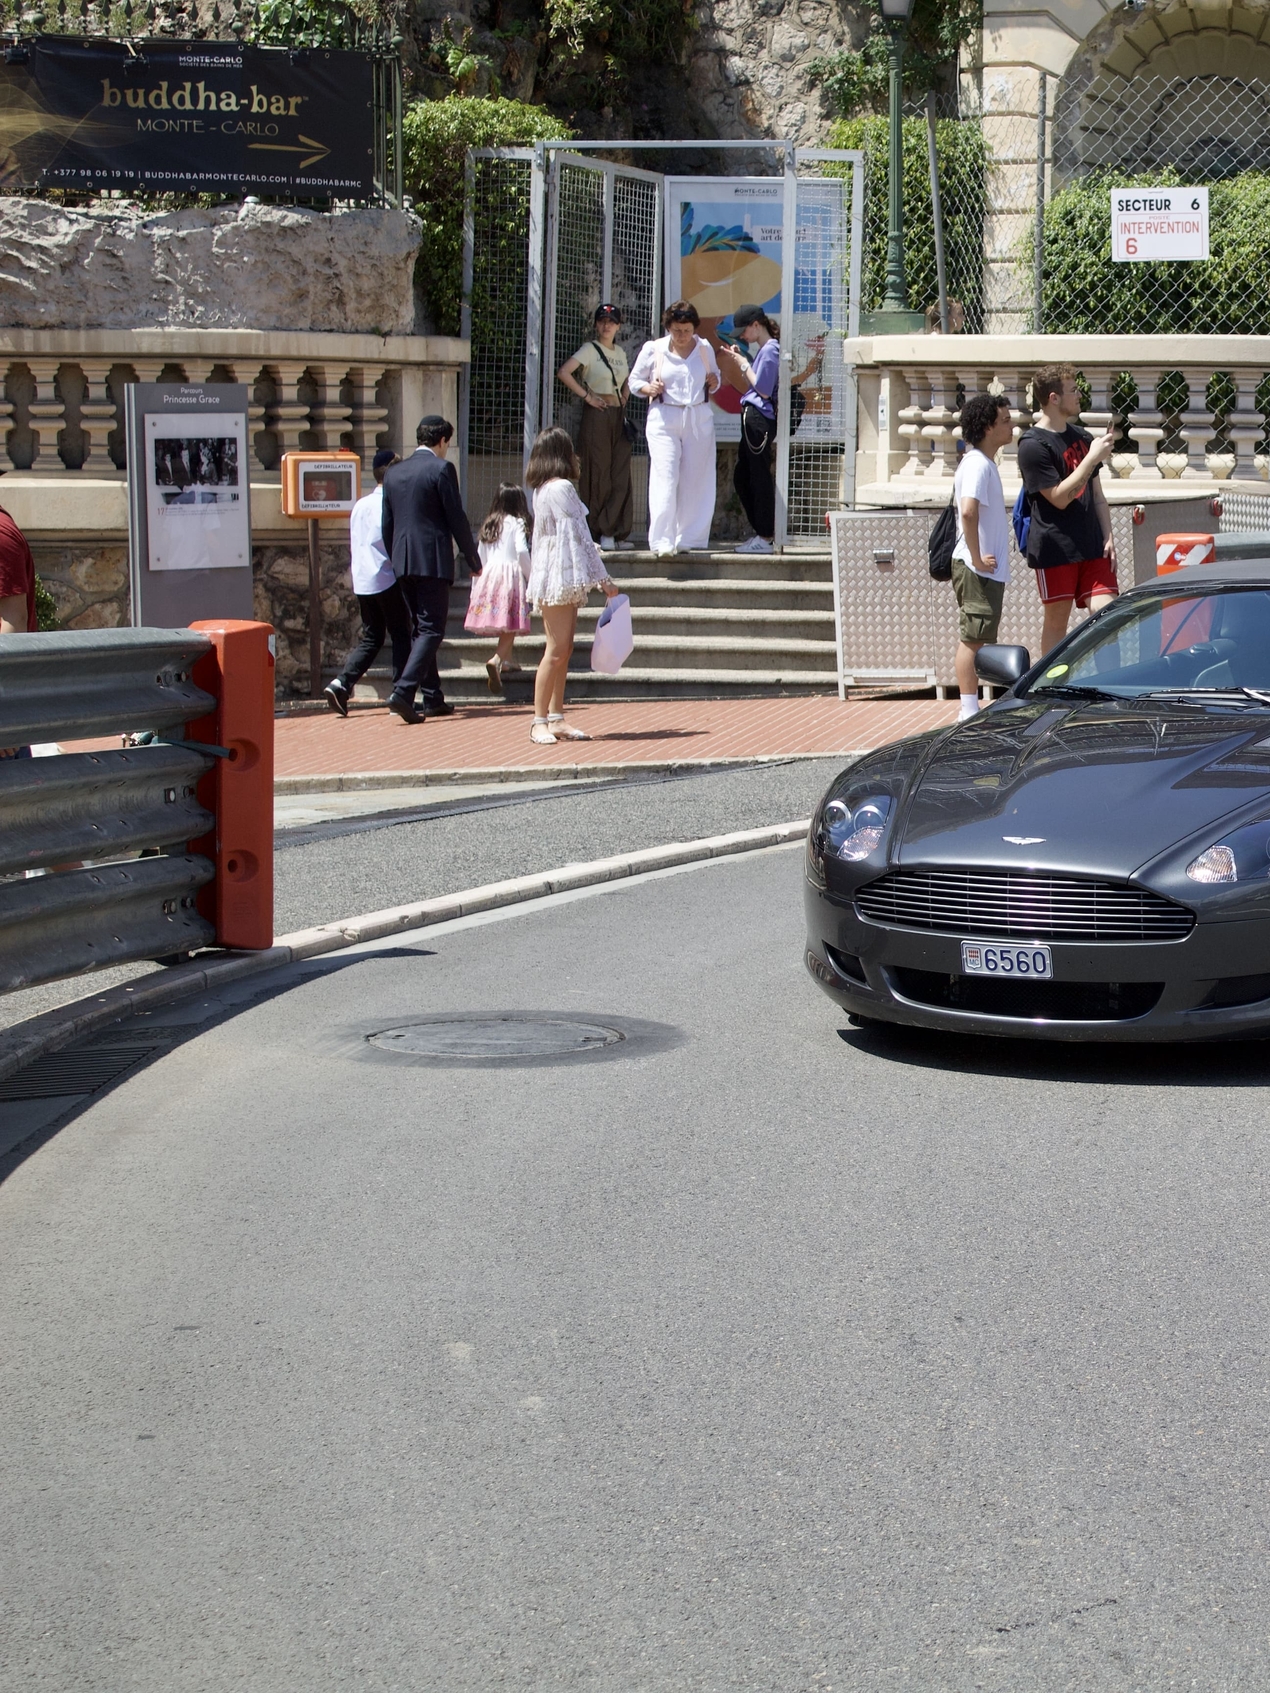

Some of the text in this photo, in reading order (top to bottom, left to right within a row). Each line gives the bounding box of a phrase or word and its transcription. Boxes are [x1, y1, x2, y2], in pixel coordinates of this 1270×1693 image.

[101, 78, 302, 116] buddha-bar
[137, 119, 205, 133] MONTE
[221, 120, 279, 136] CARLO
[42, 168, 50, 176] T.
[145, 171, 287, 183] BUDDHABARMONTECARLO.COM
[295, 178, 362, 188] #BUDDHABARMC
[1117, 198, 1200, 212] SECTEUR 6
[1120, 221, 1200, 235] INTERVENTION
[1126, 237, 1138, 255] 6
[163, 394, 220, 404] Princesse Grace
[984, 948, 1047, 974] 6560
